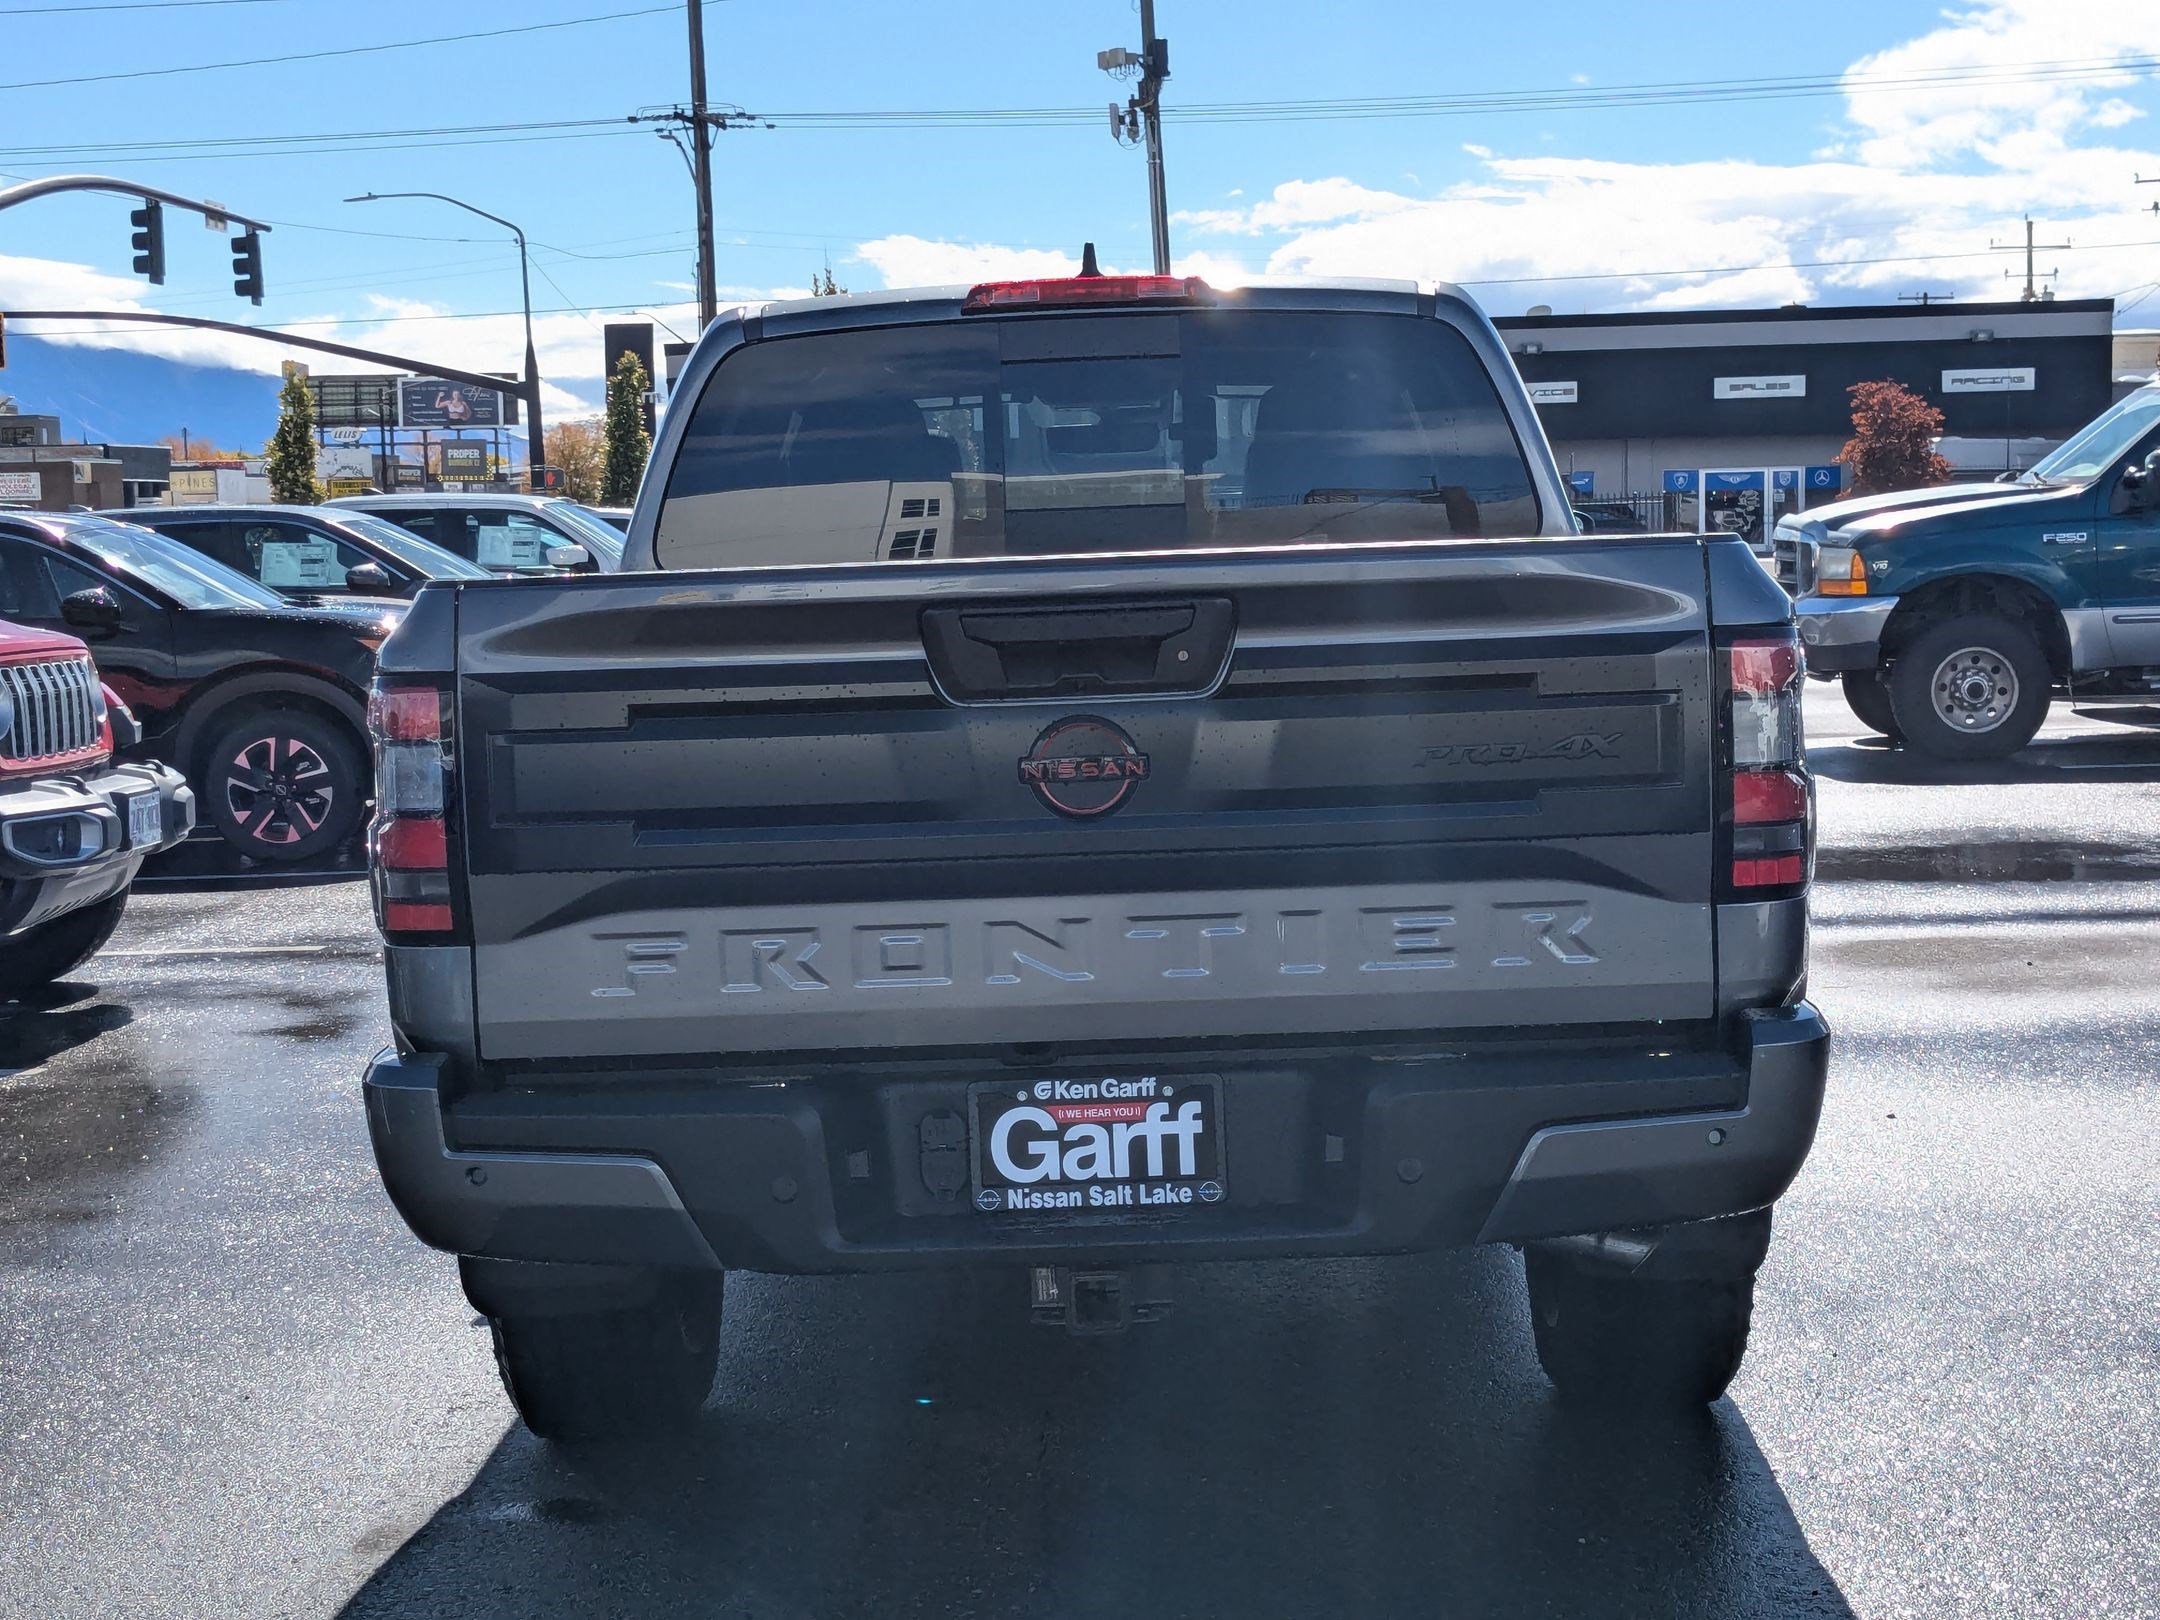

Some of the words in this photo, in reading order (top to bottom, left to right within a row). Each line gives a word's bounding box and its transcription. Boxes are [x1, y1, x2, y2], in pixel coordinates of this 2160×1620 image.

[1951, 376, 2025, 385] RACING
[1729, 383, 1790, 392] SALES
[447, 448, 480, 458] PROPER
[2042, 532, 2087, 543] F250
[1872, 562, 1888, 572] V10
[1023, 758, 1146, 779] NISSAN
[590, 899, 1600, 998] FRONTIER
[1054, 1080, 1098, 1100] Ken
[1101, 1077, 1156, 1098] Garff
[1084, 1108, 1112, 1118] HEAR
[990, 1100, 1203, 1184] Garff
[1007, 1188, 1082, 1209] Nissan
[1089, 1184, 1134, 1206] Salt
[1139, 1182, 1193, 1205] Lake
